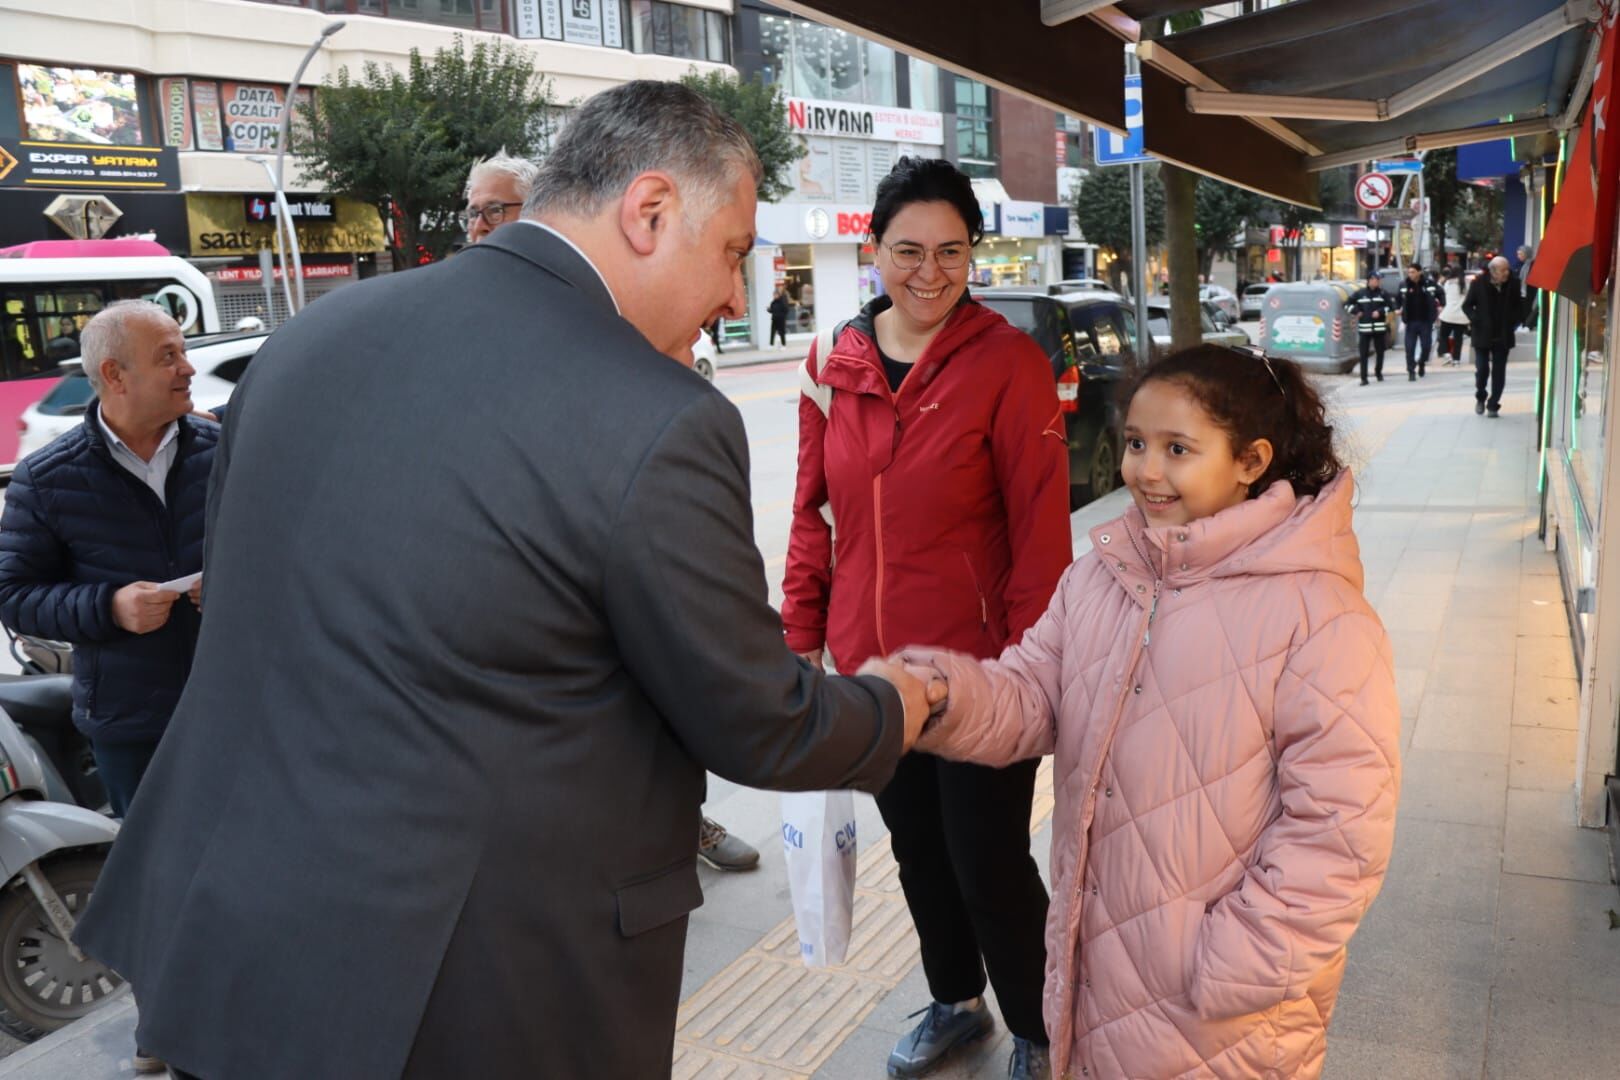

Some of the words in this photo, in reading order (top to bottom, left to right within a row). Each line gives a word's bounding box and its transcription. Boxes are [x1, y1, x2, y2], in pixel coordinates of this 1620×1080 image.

[239, 88, 275, 102] DATA
[29, 152, 88, 164] EXPER
[91, 155, 158, 167] YATIRIM
[200, 229, 251, 249] saat
